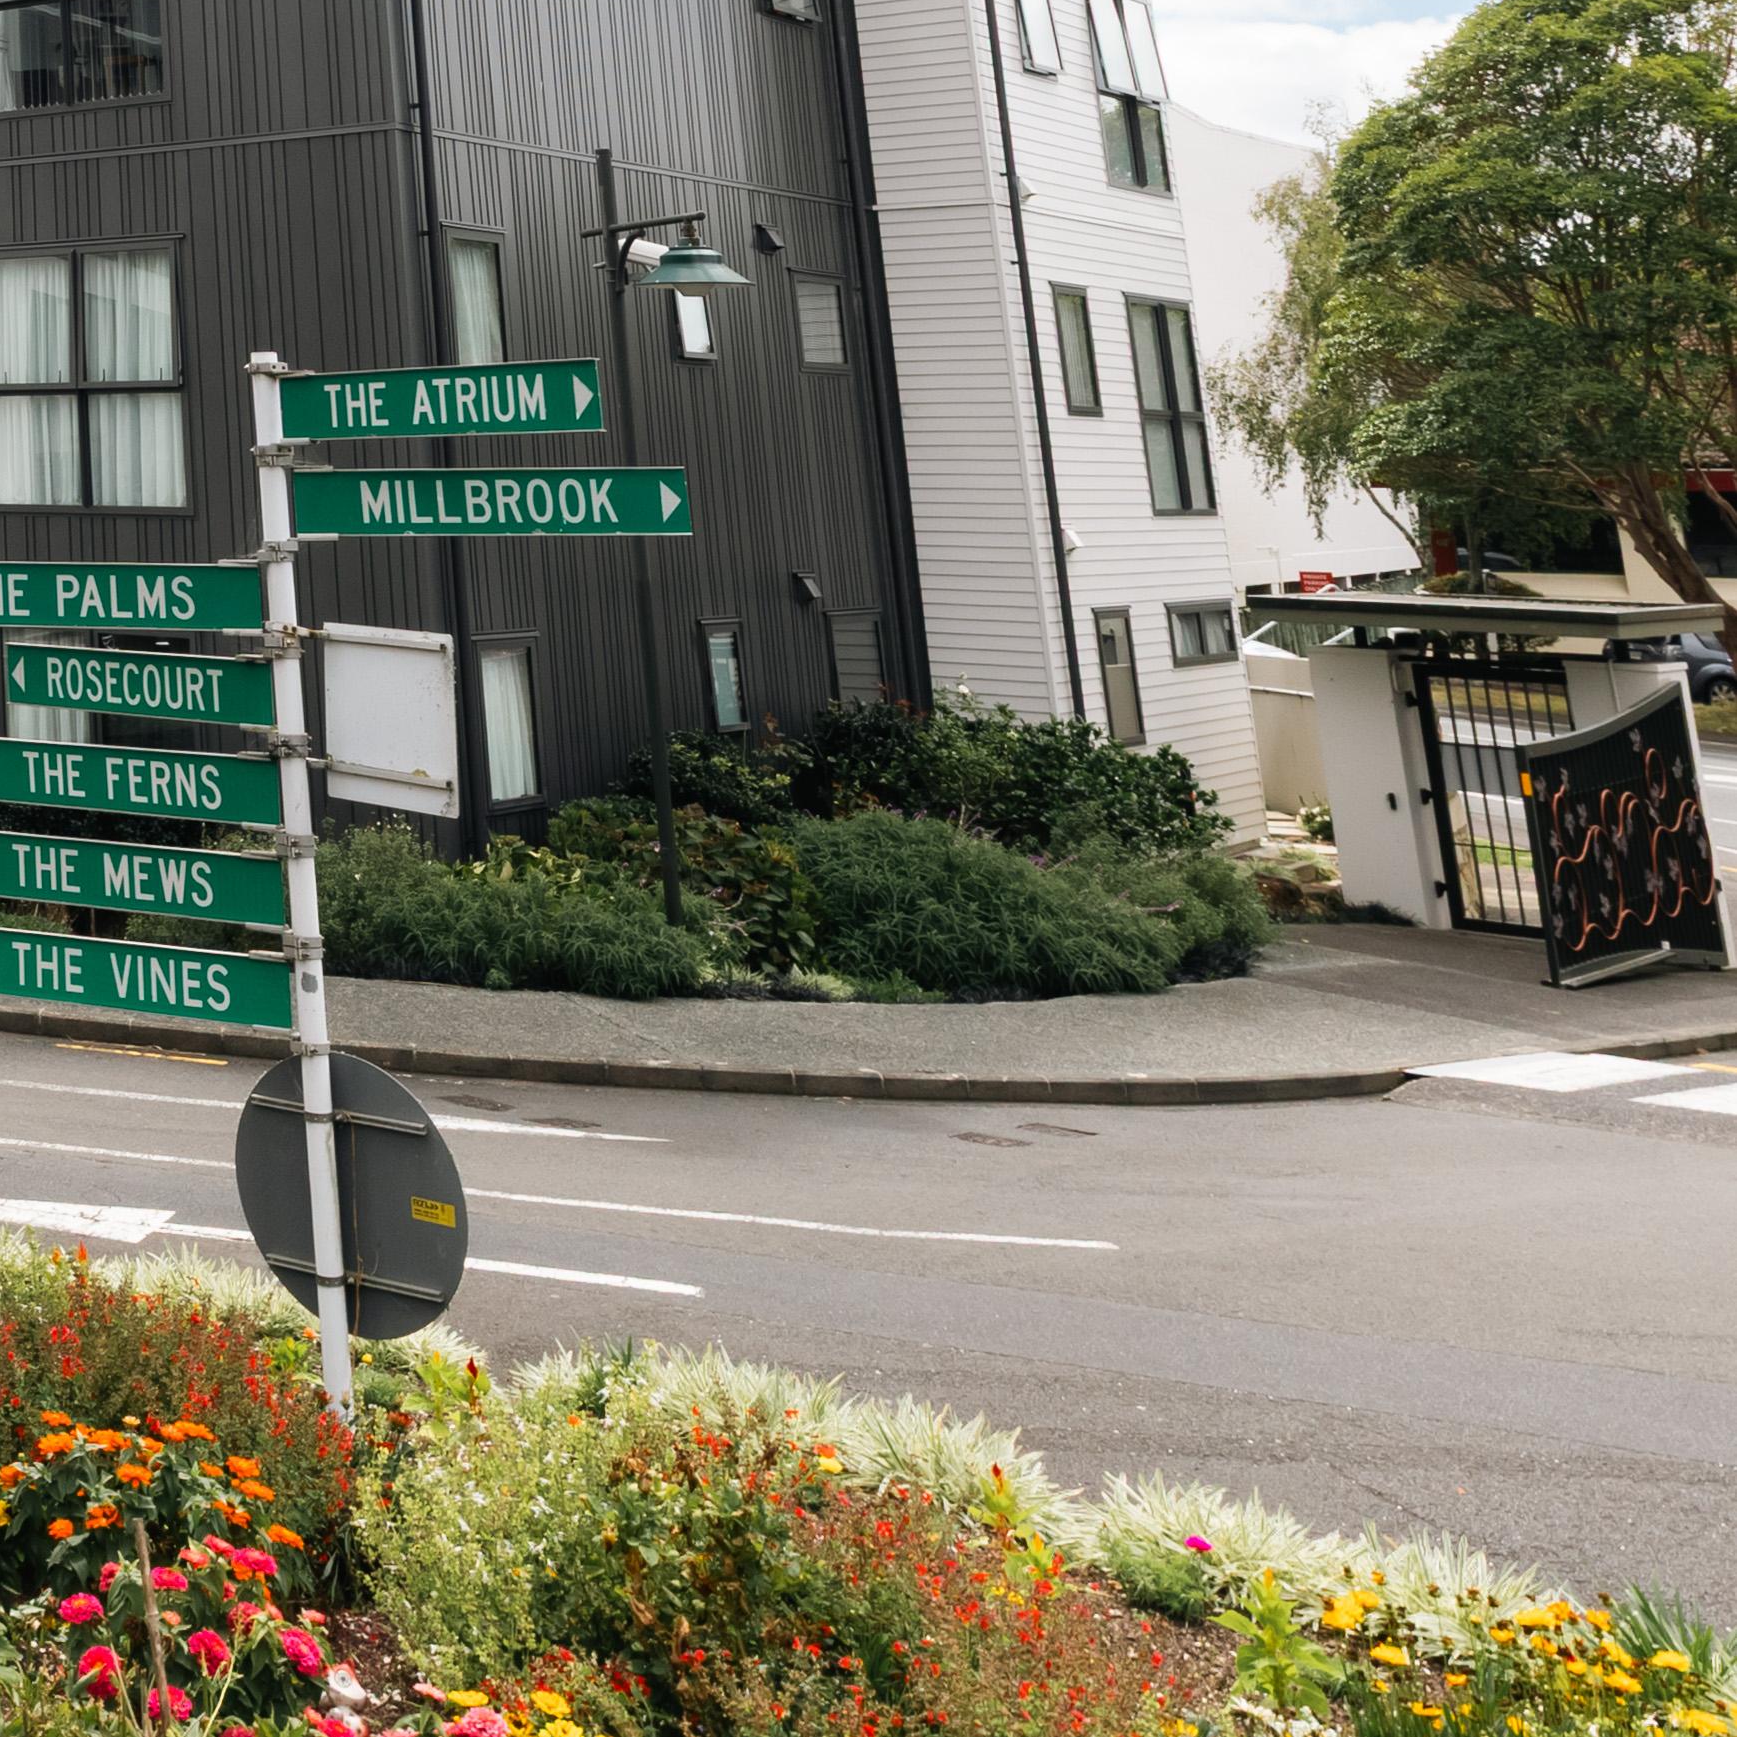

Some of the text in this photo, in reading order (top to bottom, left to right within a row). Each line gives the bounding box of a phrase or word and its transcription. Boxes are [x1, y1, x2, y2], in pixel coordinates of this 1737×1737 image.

[324, 374, 545, 427] THE ATRIUM
[361, 479, 618, 523] MILLBROOK
[57, 575, 195, 619] PALMS
[46, 658, 223, 713] ROSECOURT
[23, 752, 222, 811] THE FERNS
[13, 844, 214, 907] THE MEWS
[12, 942, 231, 1010] THE VINES
